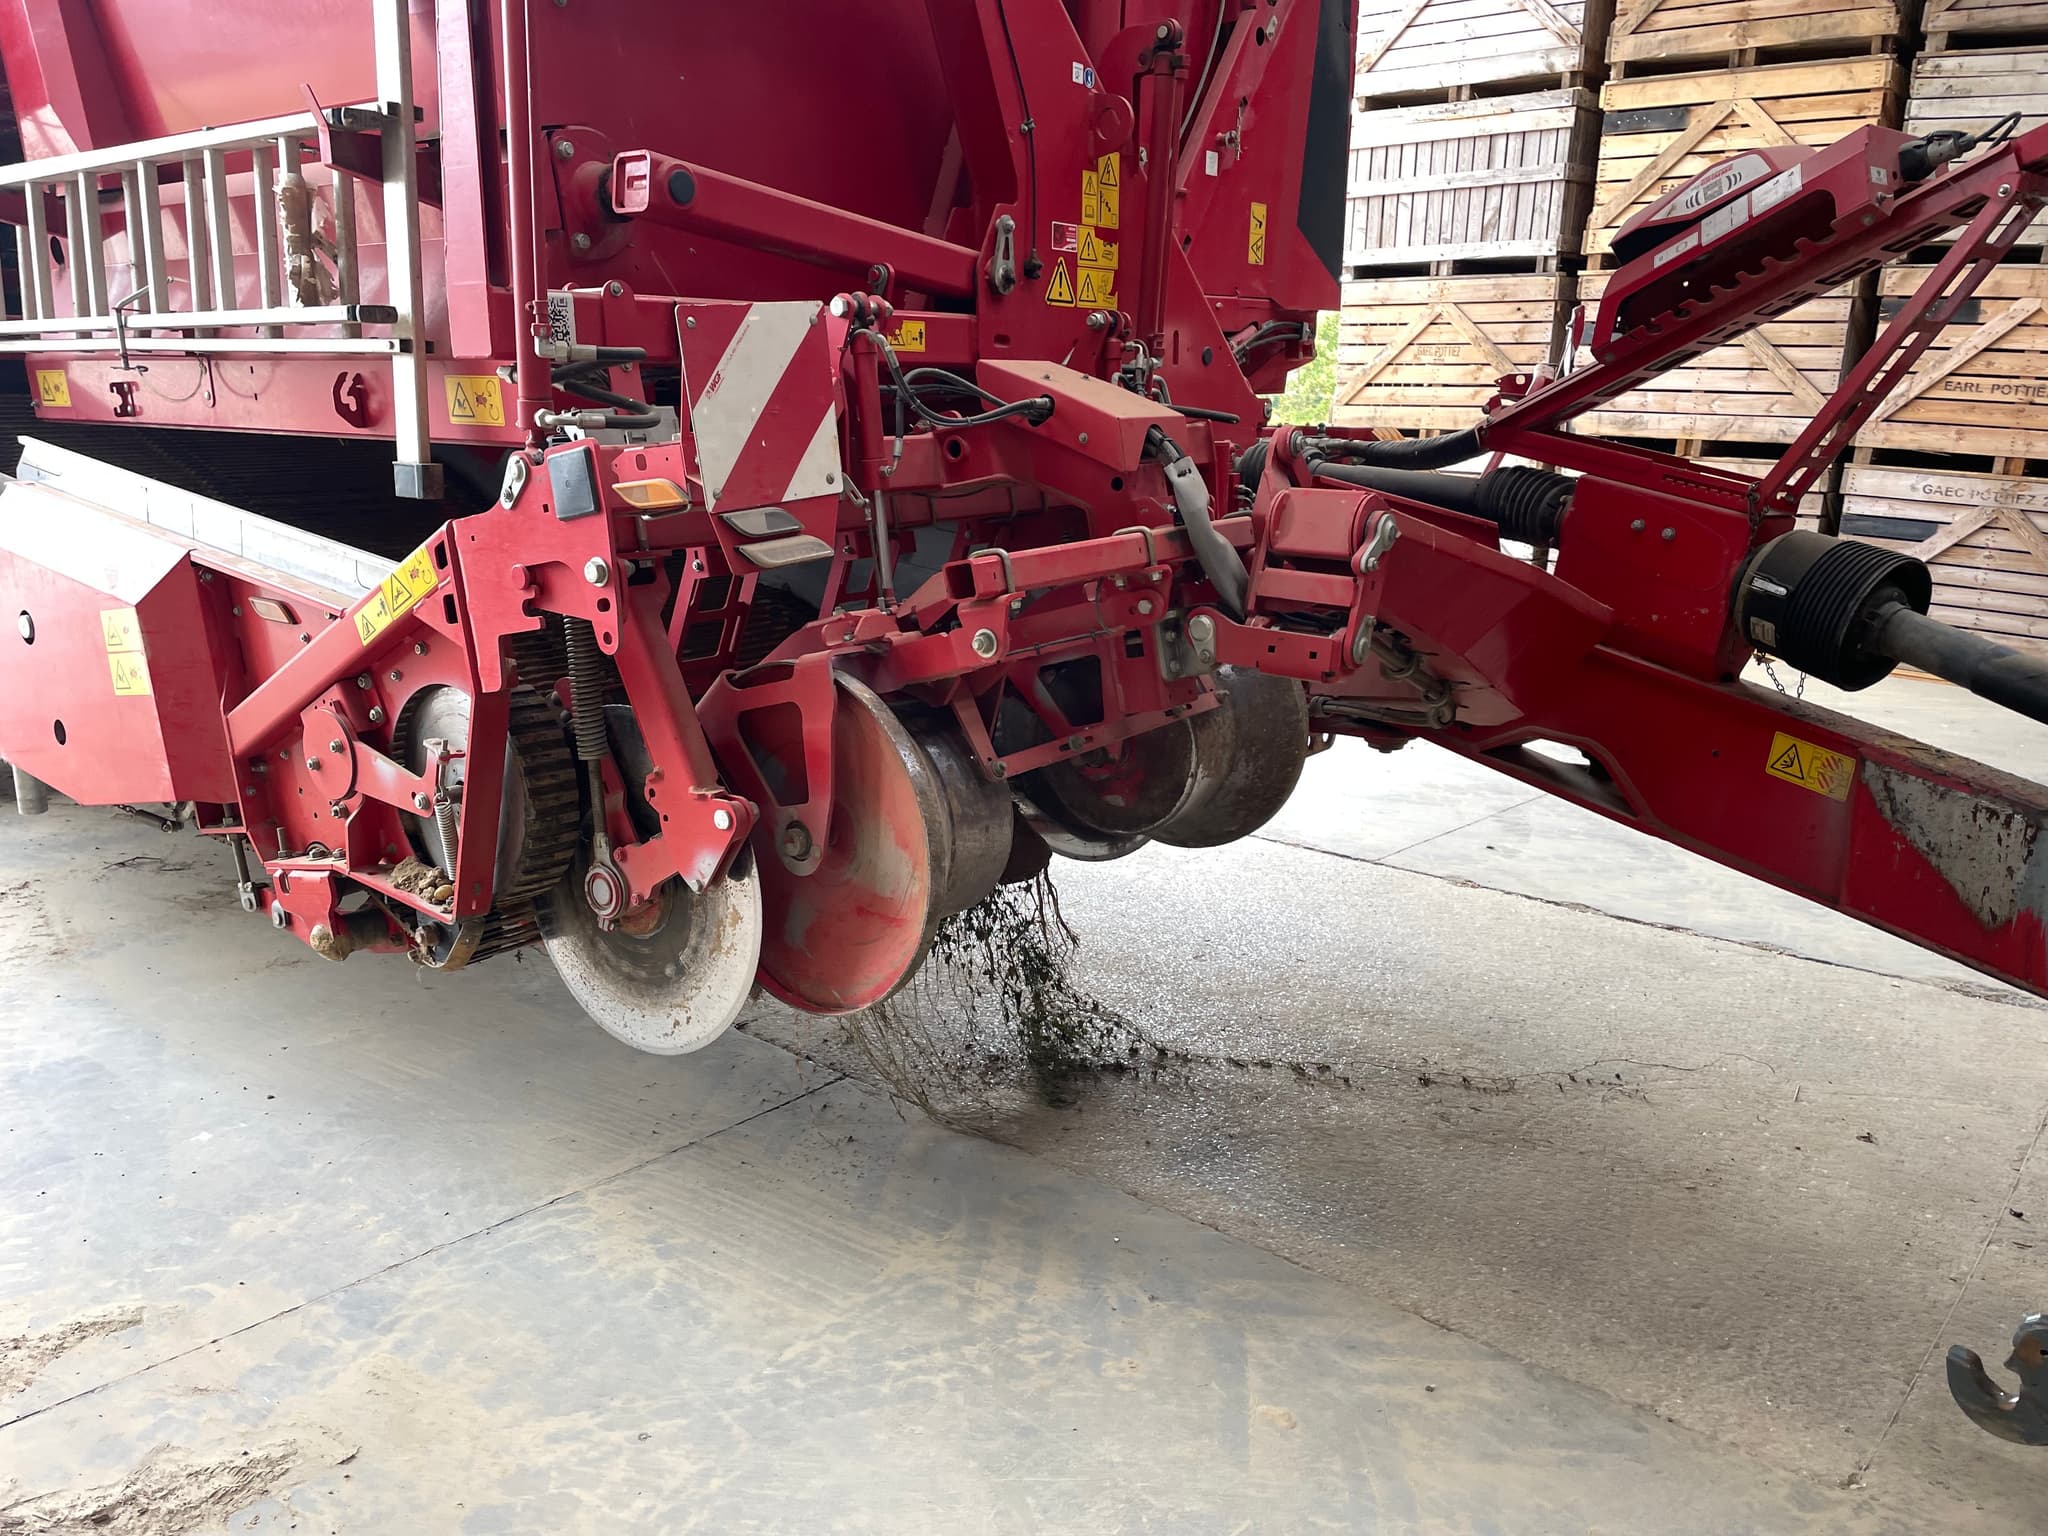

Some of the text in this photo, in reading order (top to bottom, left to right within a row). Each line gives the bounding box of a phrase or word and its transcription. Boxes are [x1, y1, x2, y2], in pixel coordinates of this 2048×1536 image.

[1944, 381, 2048, 398] EARL POTTIE
[1922, 483, 1965, 498] GAEC
